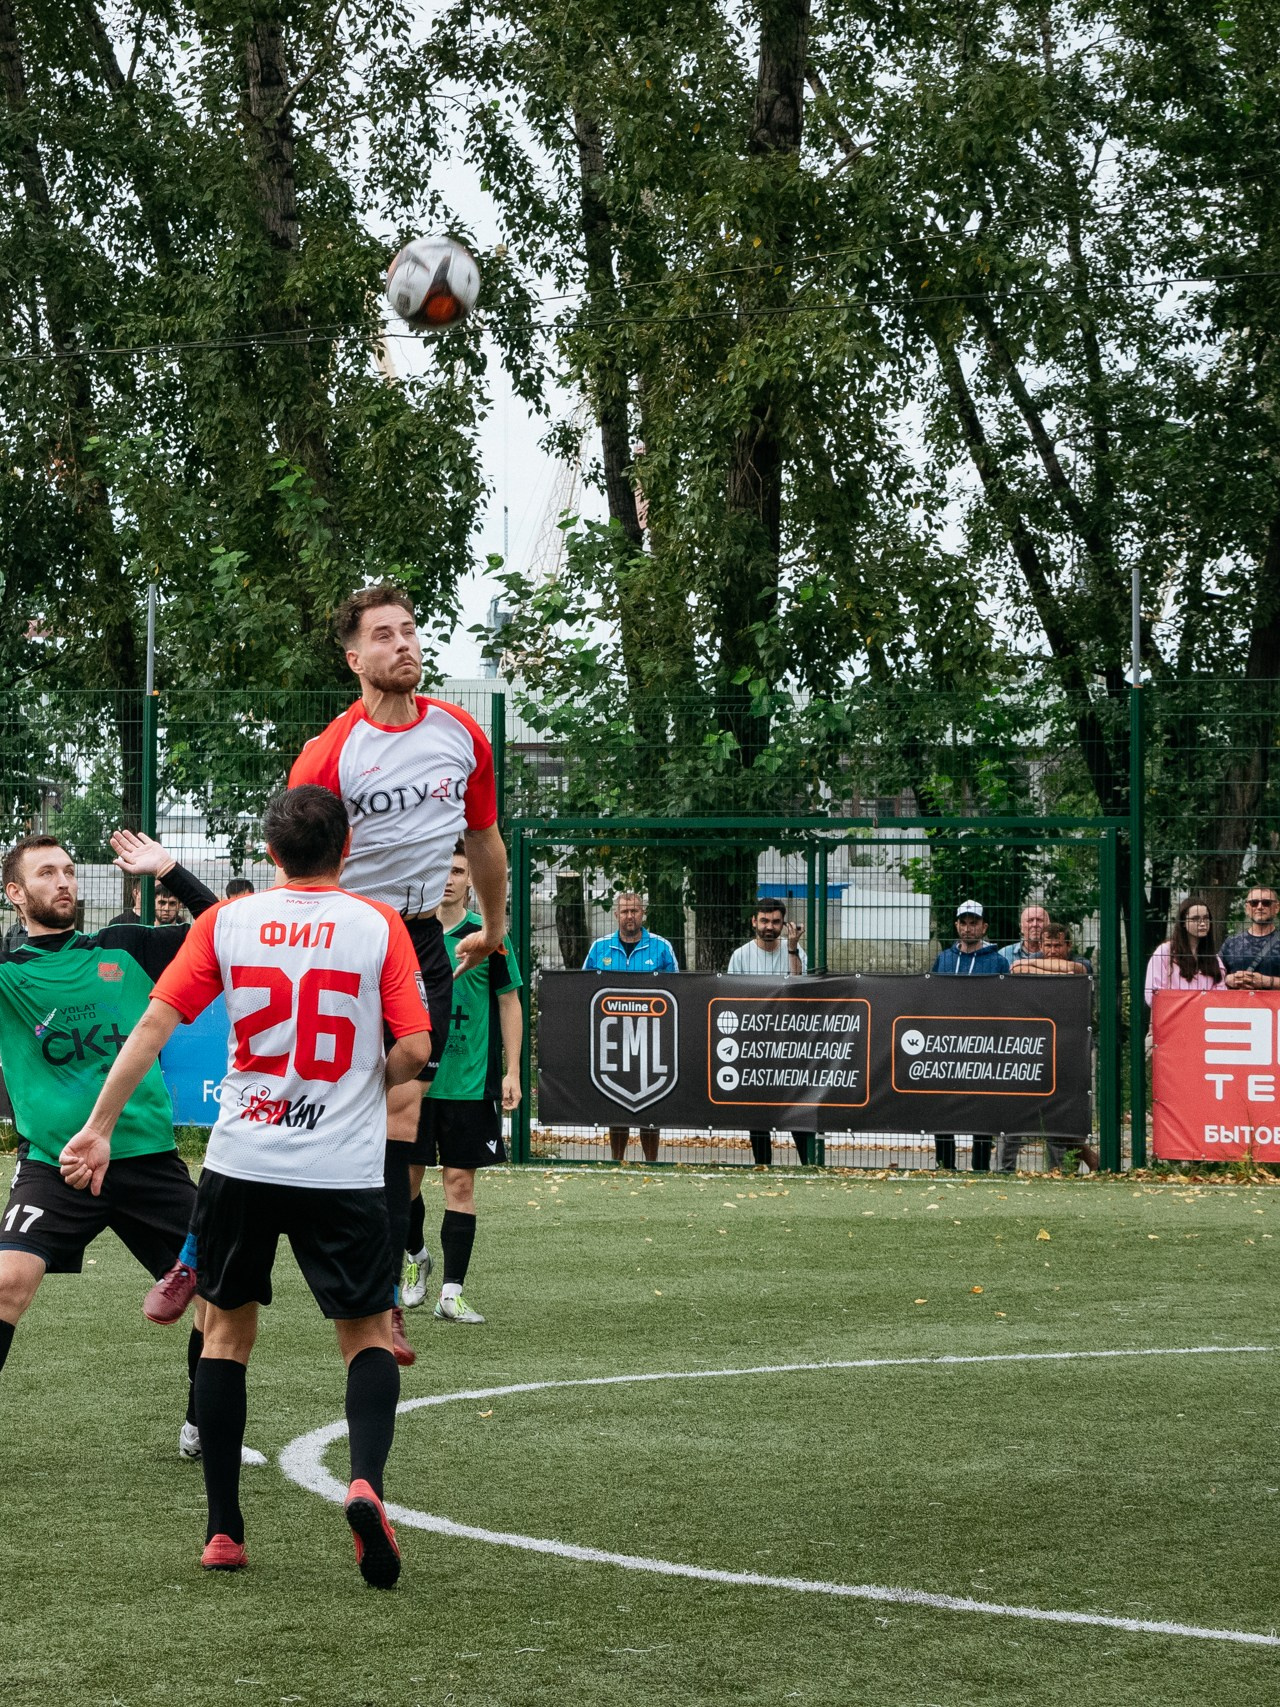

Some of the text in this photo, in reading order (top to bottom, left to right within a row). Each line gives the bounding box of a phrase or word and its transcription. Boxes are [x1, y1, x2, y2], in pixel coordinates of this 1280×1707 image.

[259, 920, 335, 949] ФИЛ
[60, 1003, 96, 1015] VOLAT
[607, 1001, 649, 1012] Winline
[66, 1011, 96, 1023] AUTO
[231, 966, 361, 1083] 26
[740, 1014, 860, 1032] EAST-LEAGUE.MEDIA
[600, 1016, 668, 1076] EML
[740, 1042, 855, 1060] EASTMEDIALEAGUE
[925, 1035, 1046, 1055] EAST.MEDIA.LEAGUE
[741, 1069, 860, 1087] EAST.MEDIA.LEAGUE
[908, 1060, 1044, 1081] @EAST.MEDIA.LEAGUE
[4, 1204, 44, 1233] 17
